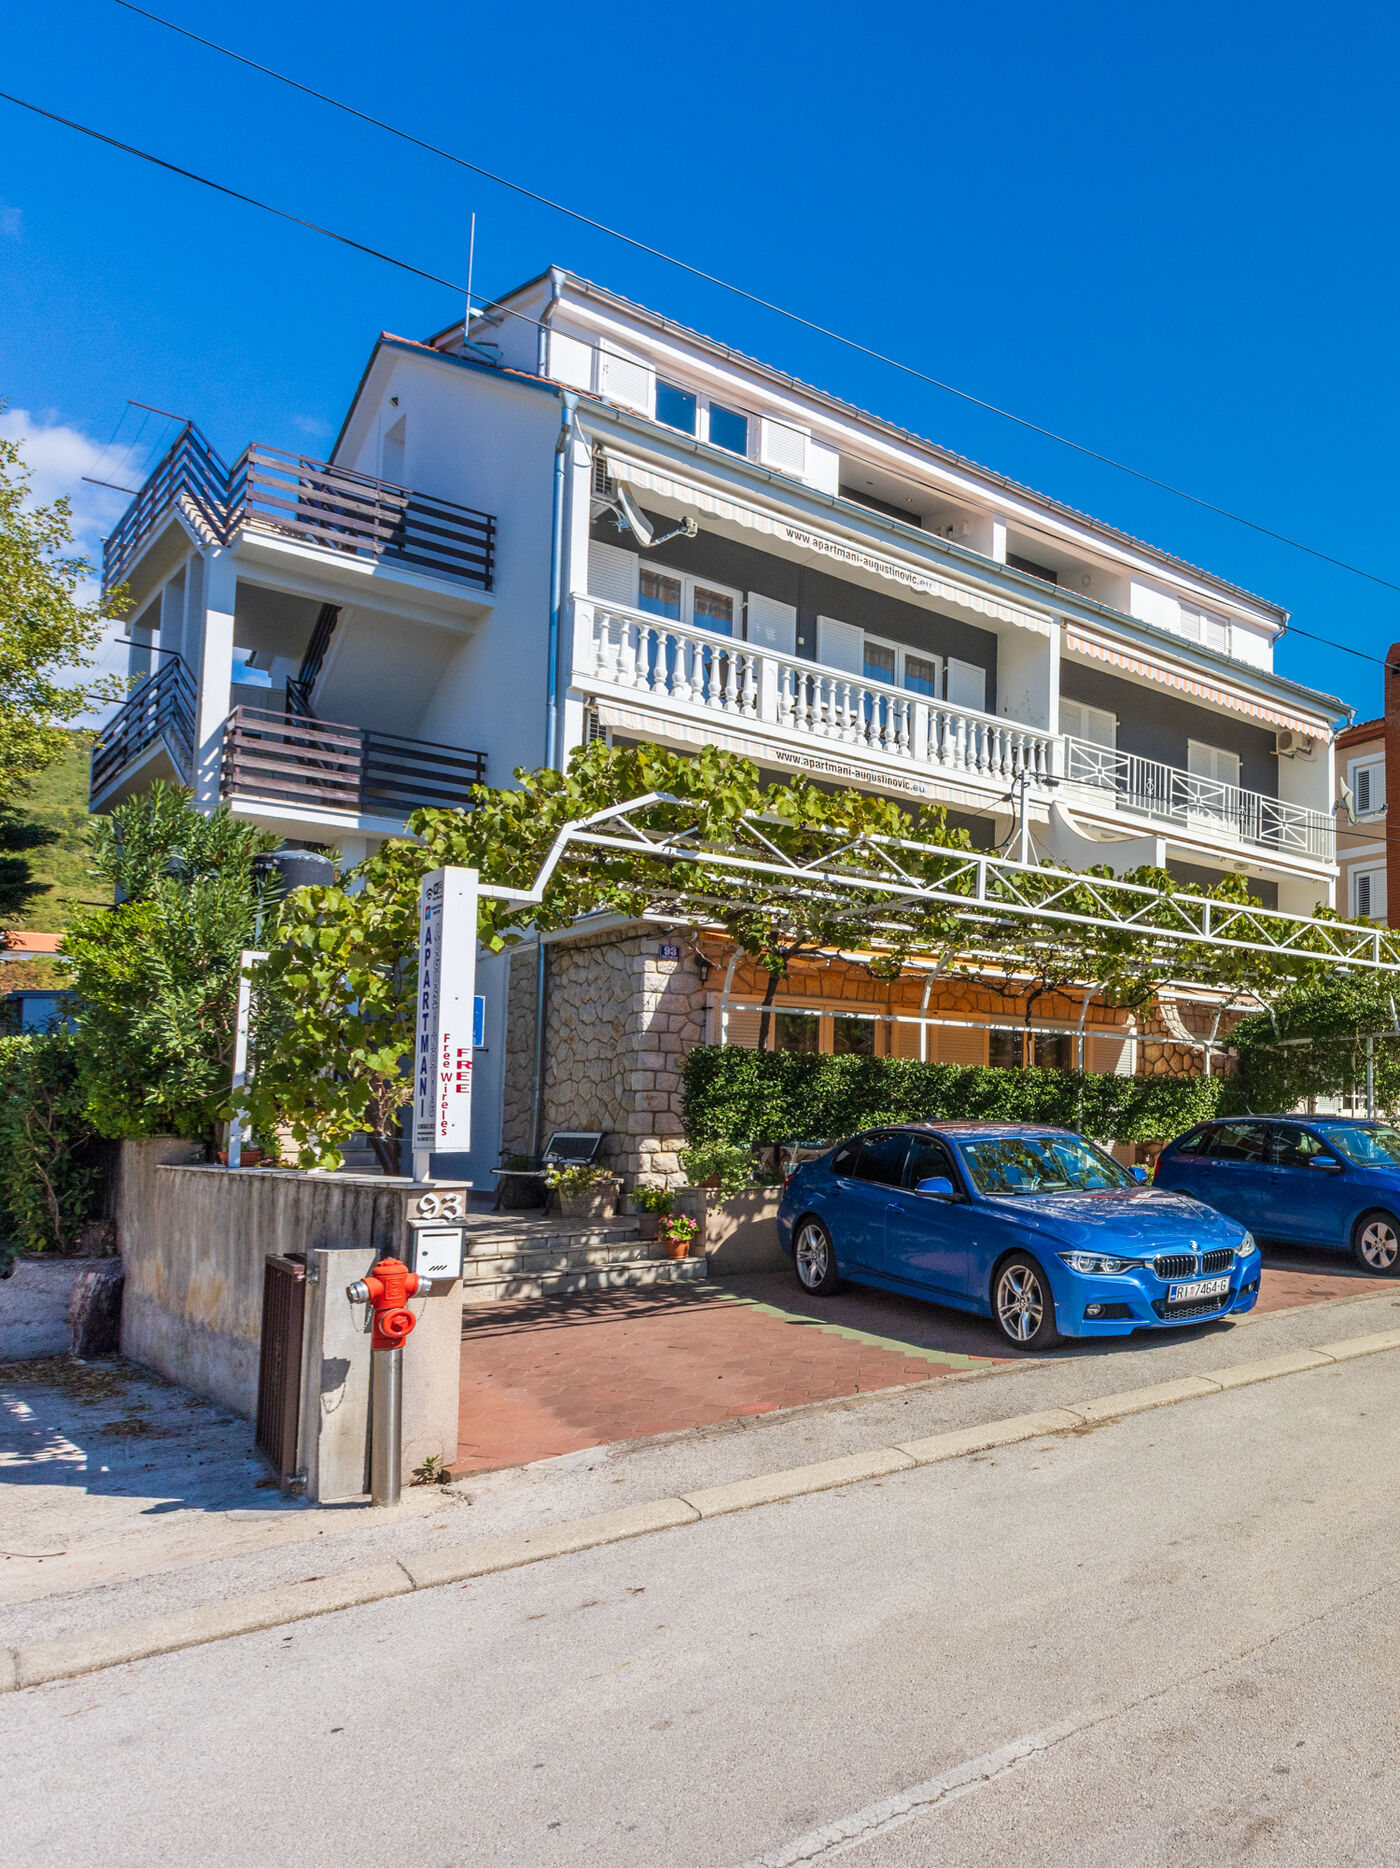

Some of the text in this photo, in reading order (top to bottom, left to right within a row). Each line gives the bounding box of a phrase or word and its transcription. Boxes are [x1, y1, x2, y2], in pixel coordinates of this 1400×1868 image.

[663, 946, 677, 956] 93
[419, 926, 432, 1118] APARTMANI
[442, 1033, 451, 1069] Free
[455, 1048, 473, 1094] FREE
[419, 1192, 463, 1219] 93
[1176, 1279, 1227, 1299] RI 7464-G
